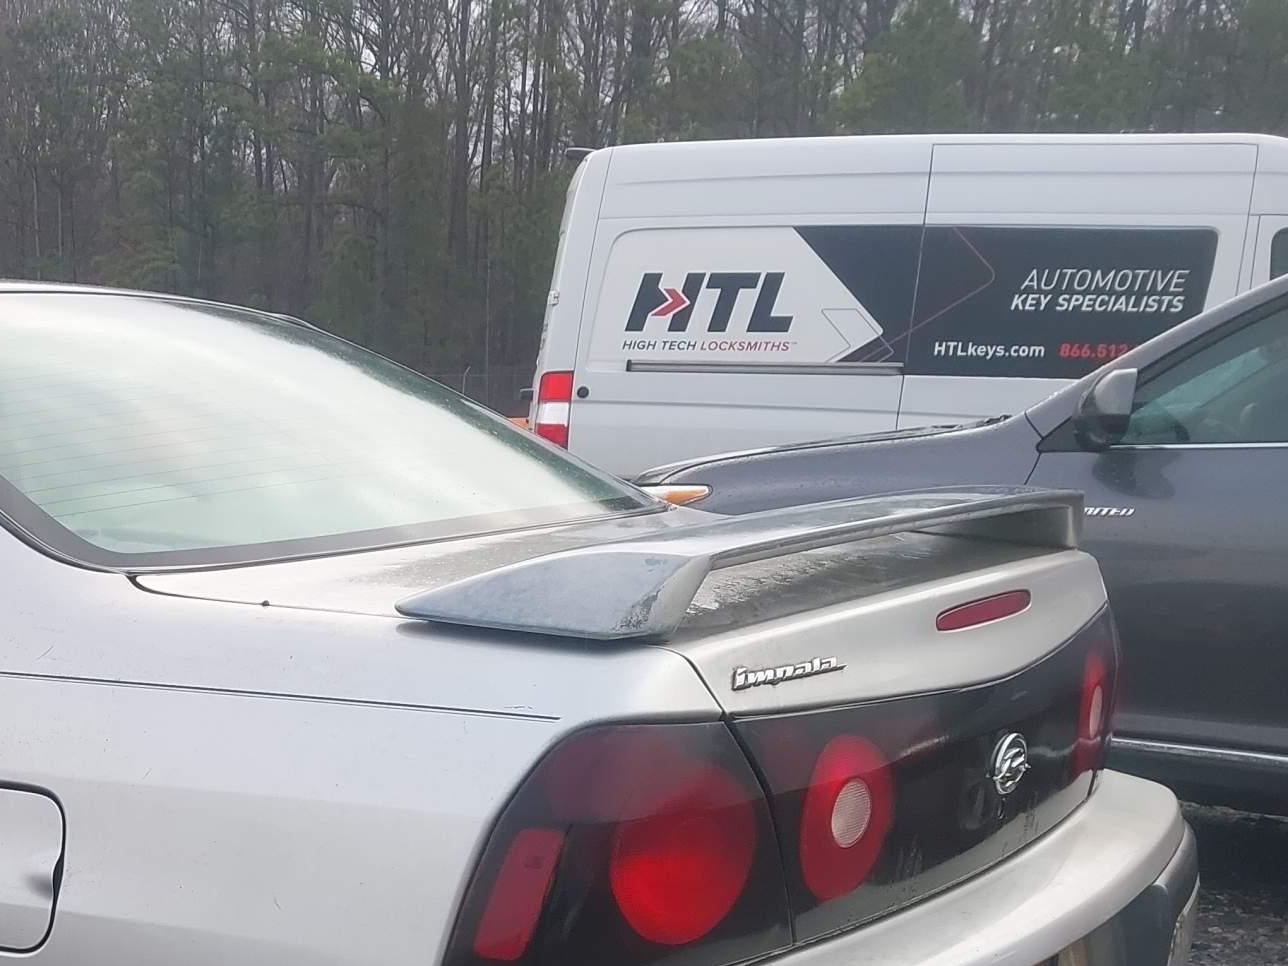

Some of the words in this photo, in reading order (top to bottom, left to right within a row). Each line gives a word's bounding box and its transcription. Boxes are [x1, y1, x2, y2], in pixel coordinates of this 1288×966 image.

[1020, 268, 1190, 292] AUTOMOTIVE
[624, 272, 794, 333] HTL
[1010, 294, 1054, 311] KEY
[1055, 295, 1186, 313] SPECIALISTS
[622, 340, 657, 351] HIGH
[662, 340, 697, 351] TECH
[700, 341, 791, 352] LOCKSMITHS
[933, 341, 1046, 360] HTLkeys.com
